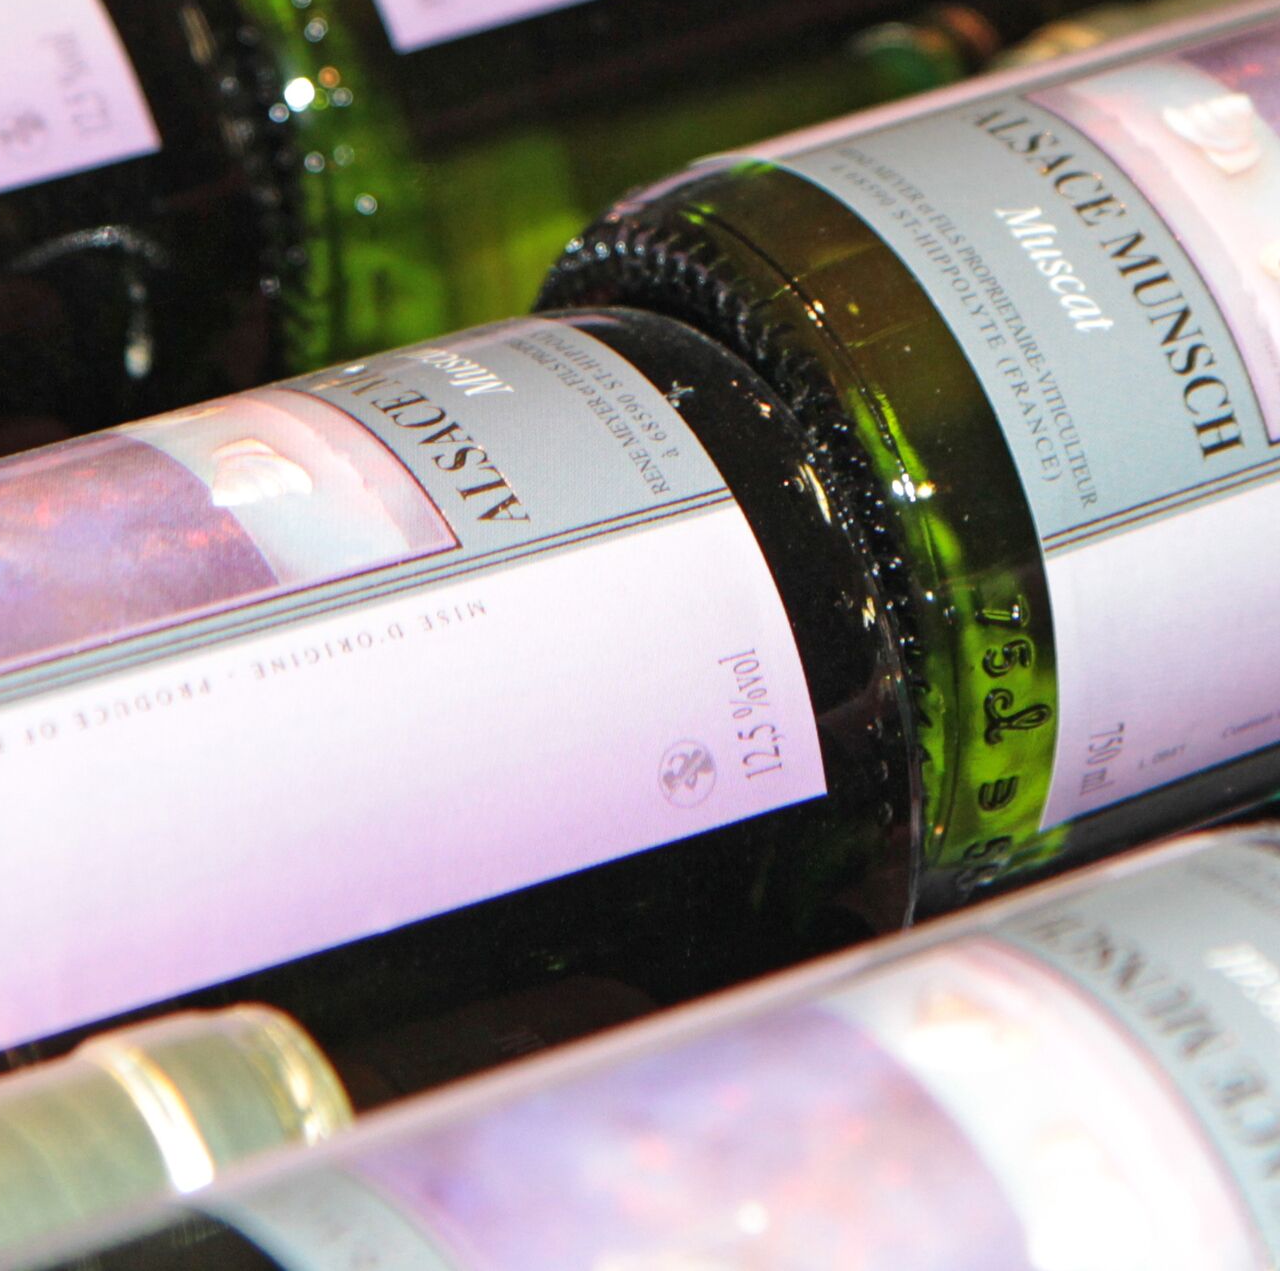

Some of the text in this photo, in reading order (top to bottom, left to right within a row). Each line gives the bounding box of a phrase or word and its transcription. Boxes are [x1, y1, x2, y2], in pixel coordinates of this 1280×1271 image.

[968, 106, 1247, 461] ALSACE MUNSCH
[992, 204, 1115, 336] Muscat
[892, 204, 1006, 350] ST-HIPPOLYTE
[994, 353, 1065, 485] (FRANCE)
[927, 210, 968, 247] FILS
[962, 241, 1099, 510] PROPRIETAIRE-VITICULTEUR
[587, 396, 640, 452] MEYER
[615, 391, 670, 444] 68590
[370, 386, 532, 524] ALSACE
[631, 448, 672, 497] RENE
[420, 597, 488, 634] MISE
[249, 621, 406, 683] D'ORIGINE
[22, 720, 61, 746] OF
[74, 679, 215, 733] PRODUCE
[716, 647, 784, 782] 12,5 %vol
